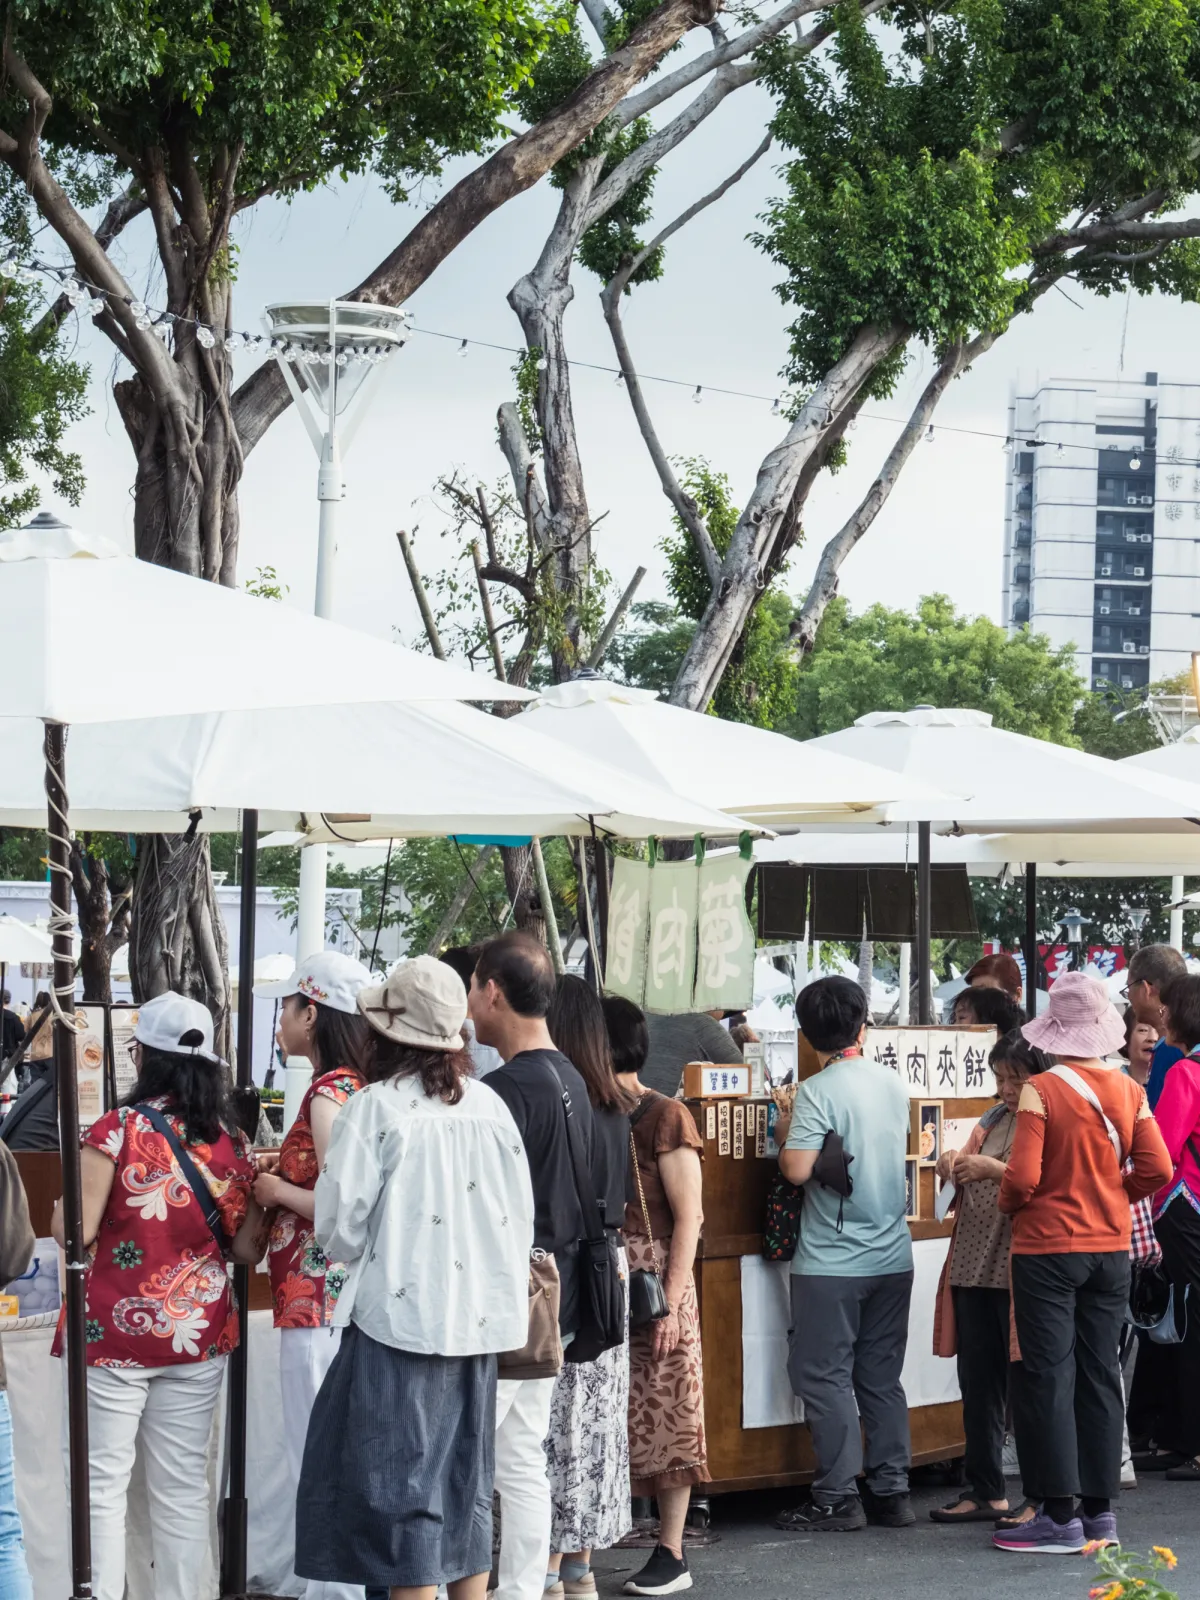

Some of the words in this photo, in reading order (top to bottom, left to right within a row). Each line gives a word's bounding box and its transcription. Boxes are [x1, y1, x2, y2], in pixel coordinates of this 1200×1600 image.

[709, 1071, 739, 1091] 營業中
[874, 1042, 986, 1088] 燒肉夾餅
